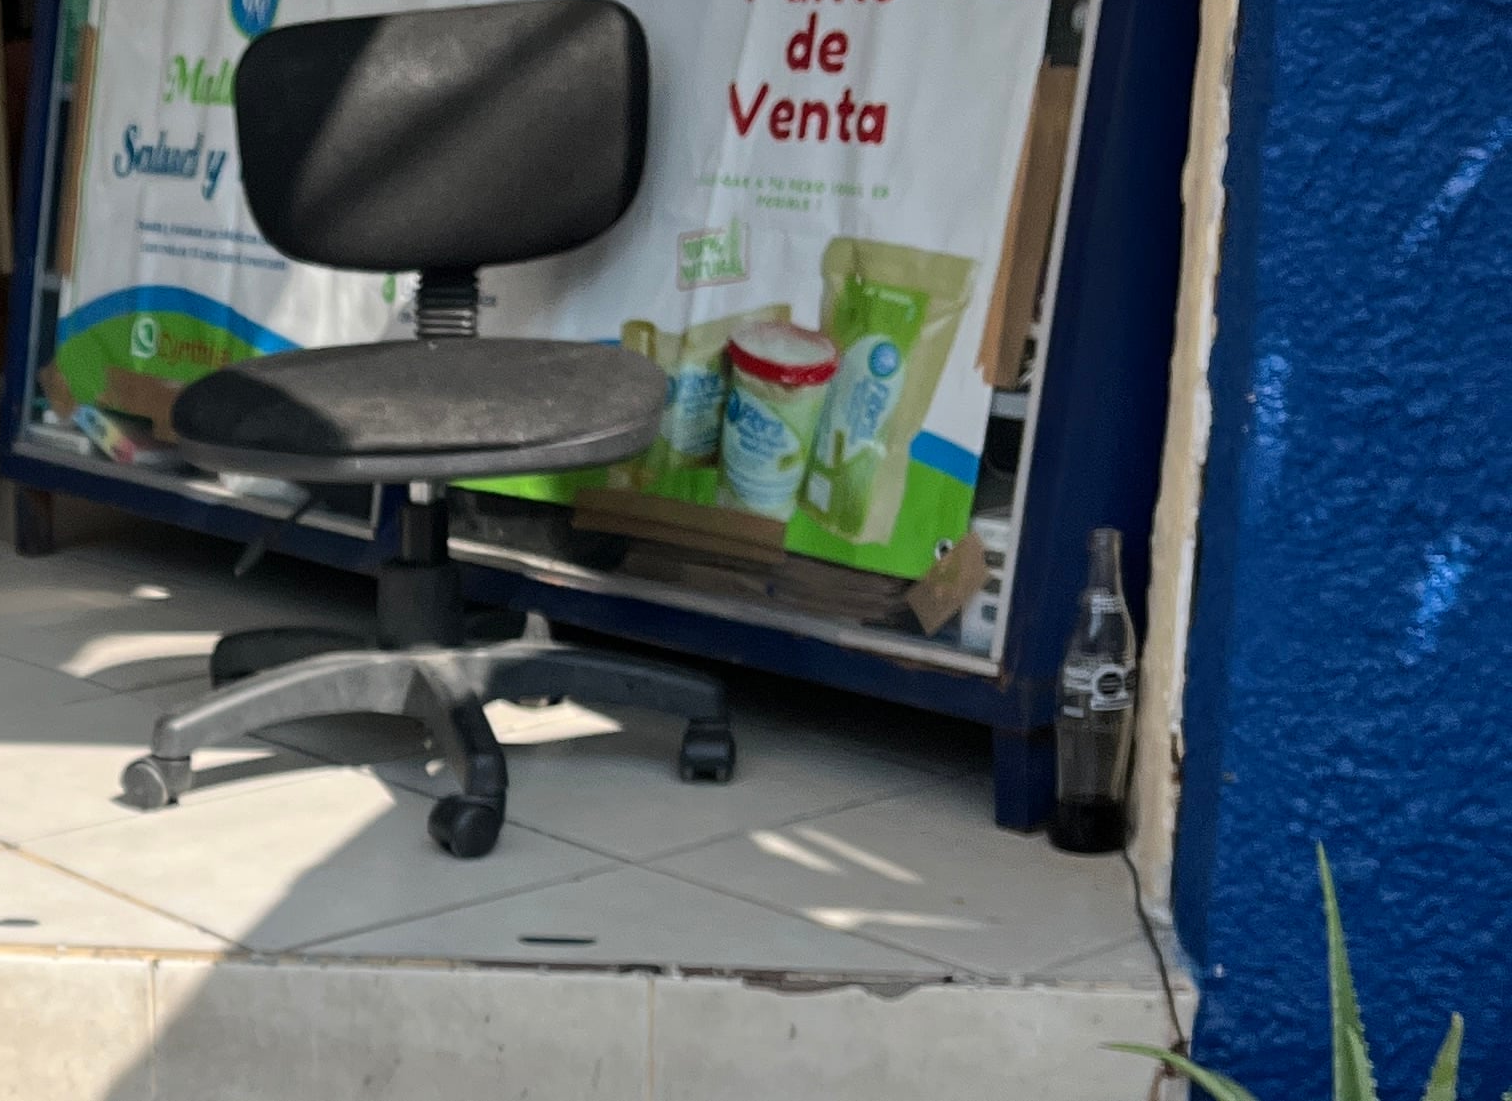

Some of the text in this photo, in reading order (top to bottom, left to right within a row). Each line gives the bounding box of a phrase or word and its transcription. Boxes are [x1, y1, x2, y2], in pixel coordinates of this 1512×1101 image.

[786, 12, 850, 73] de
[729, 82, 887, 145] Venta
[114, 122, 227, 201] Salud y
